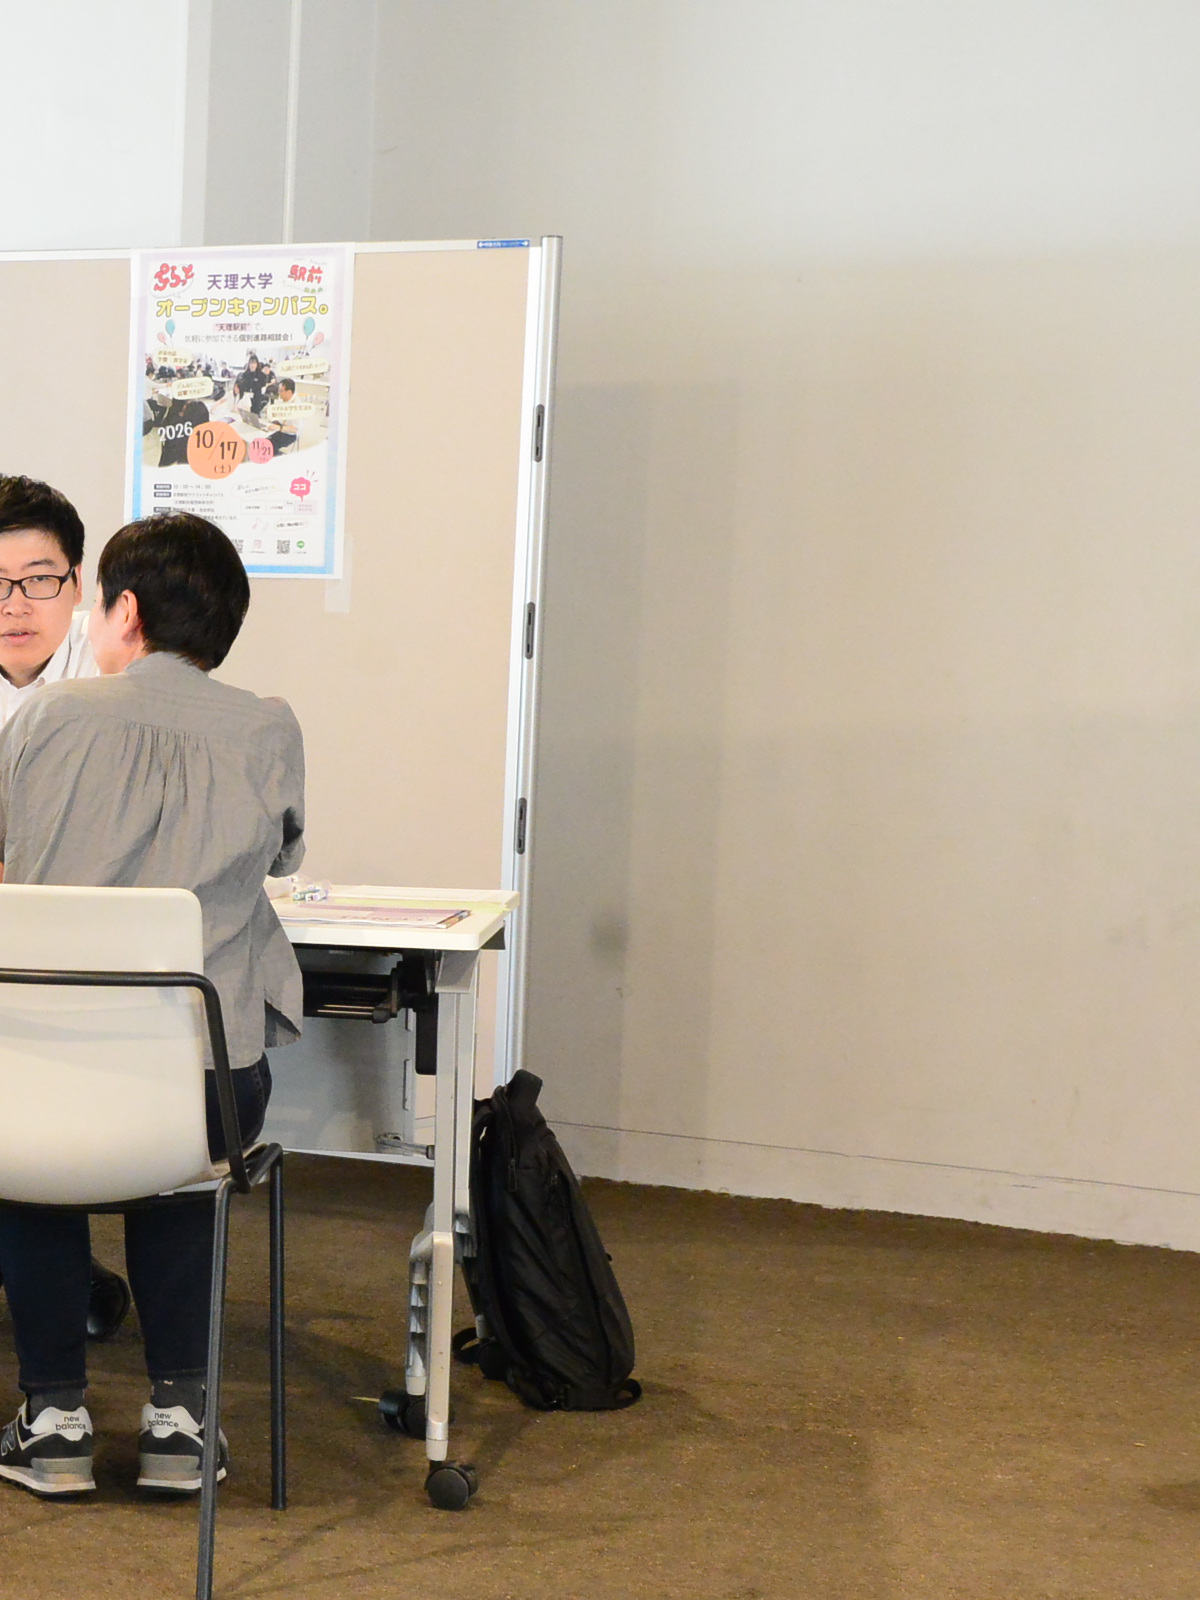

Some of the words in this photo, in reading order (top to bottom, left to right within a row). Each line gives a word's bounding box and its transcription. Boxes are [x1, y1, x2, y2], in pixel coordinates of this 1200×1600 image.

[153, 263, 195, 291] ぷらっと
[207, 272, 274, 290] 天理大学
[287, 264, 324, 284] 駅前
[156, 296, 329, 317] オープンキャンパス。
[157, 421, 194, 442] 2026
[195, 430, 238, 461] 10/17
[213, 464, 232, 474] (土)
[293, 483, 307, 491] ココ
[63, 1415, 80, 1423] new
[154, 1412, 172, 1420] new
[55, 1422, 87, 1431] balance
[147, 1419, 179, 1429] balance
